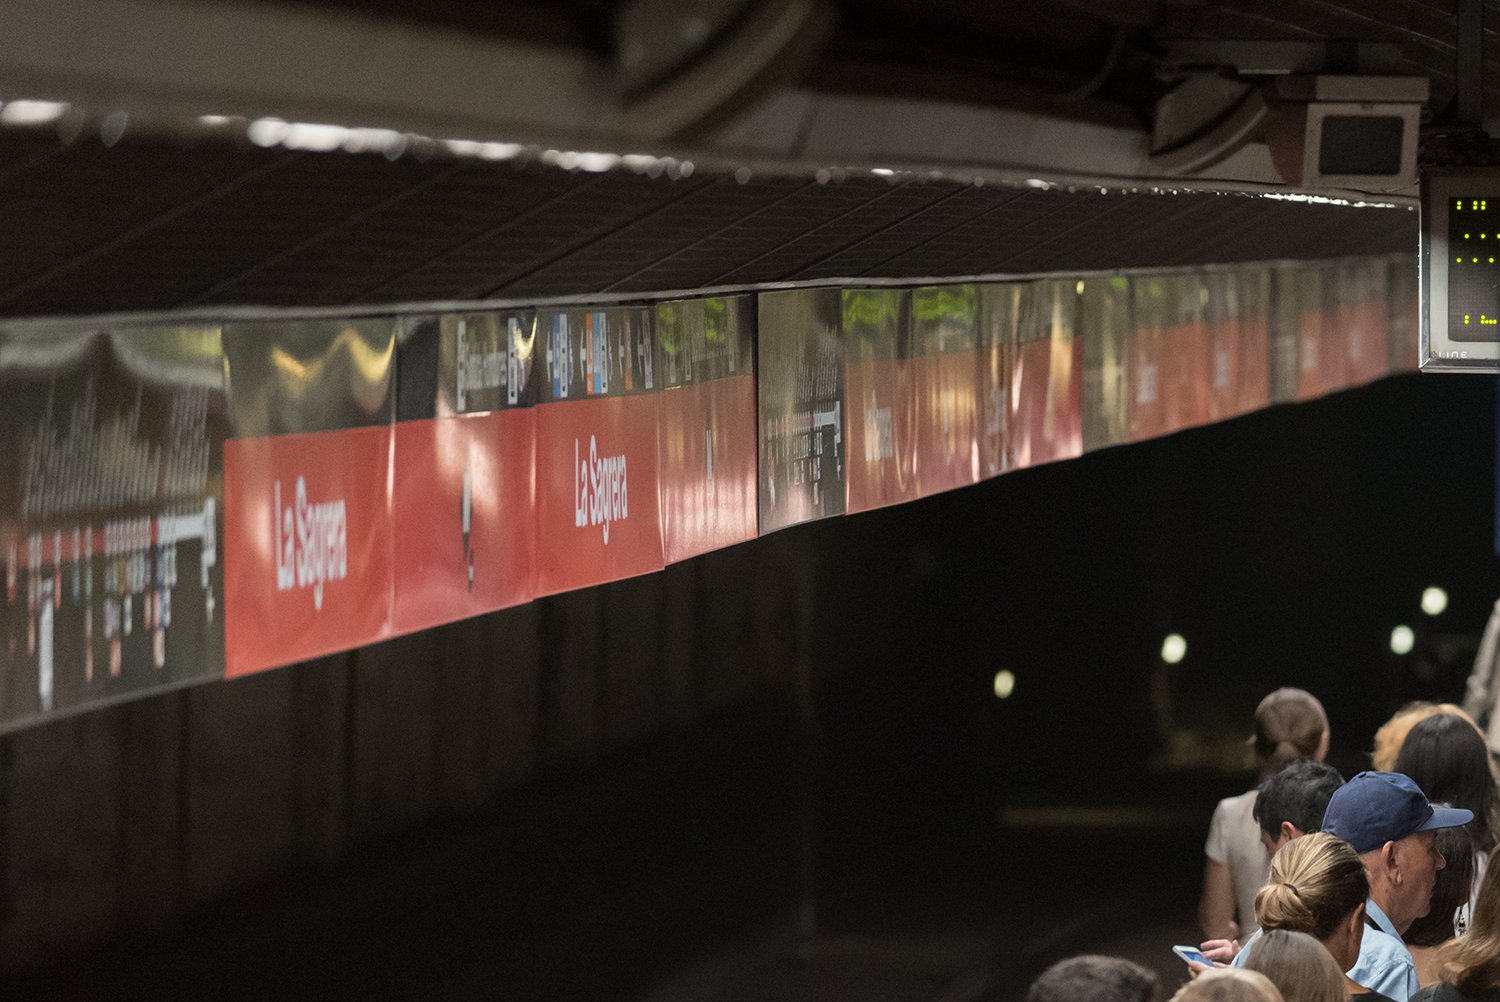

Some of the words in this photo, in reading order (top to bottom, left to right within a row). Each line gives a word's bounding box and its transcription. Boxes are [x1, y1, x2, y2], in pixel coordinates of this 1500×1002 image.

[274, 479, 296, 591] La
[296, 475, 348, 613] Sagrera
[574, 437, 588, 528] La
[589, 434, 629, 546] Sagrera
